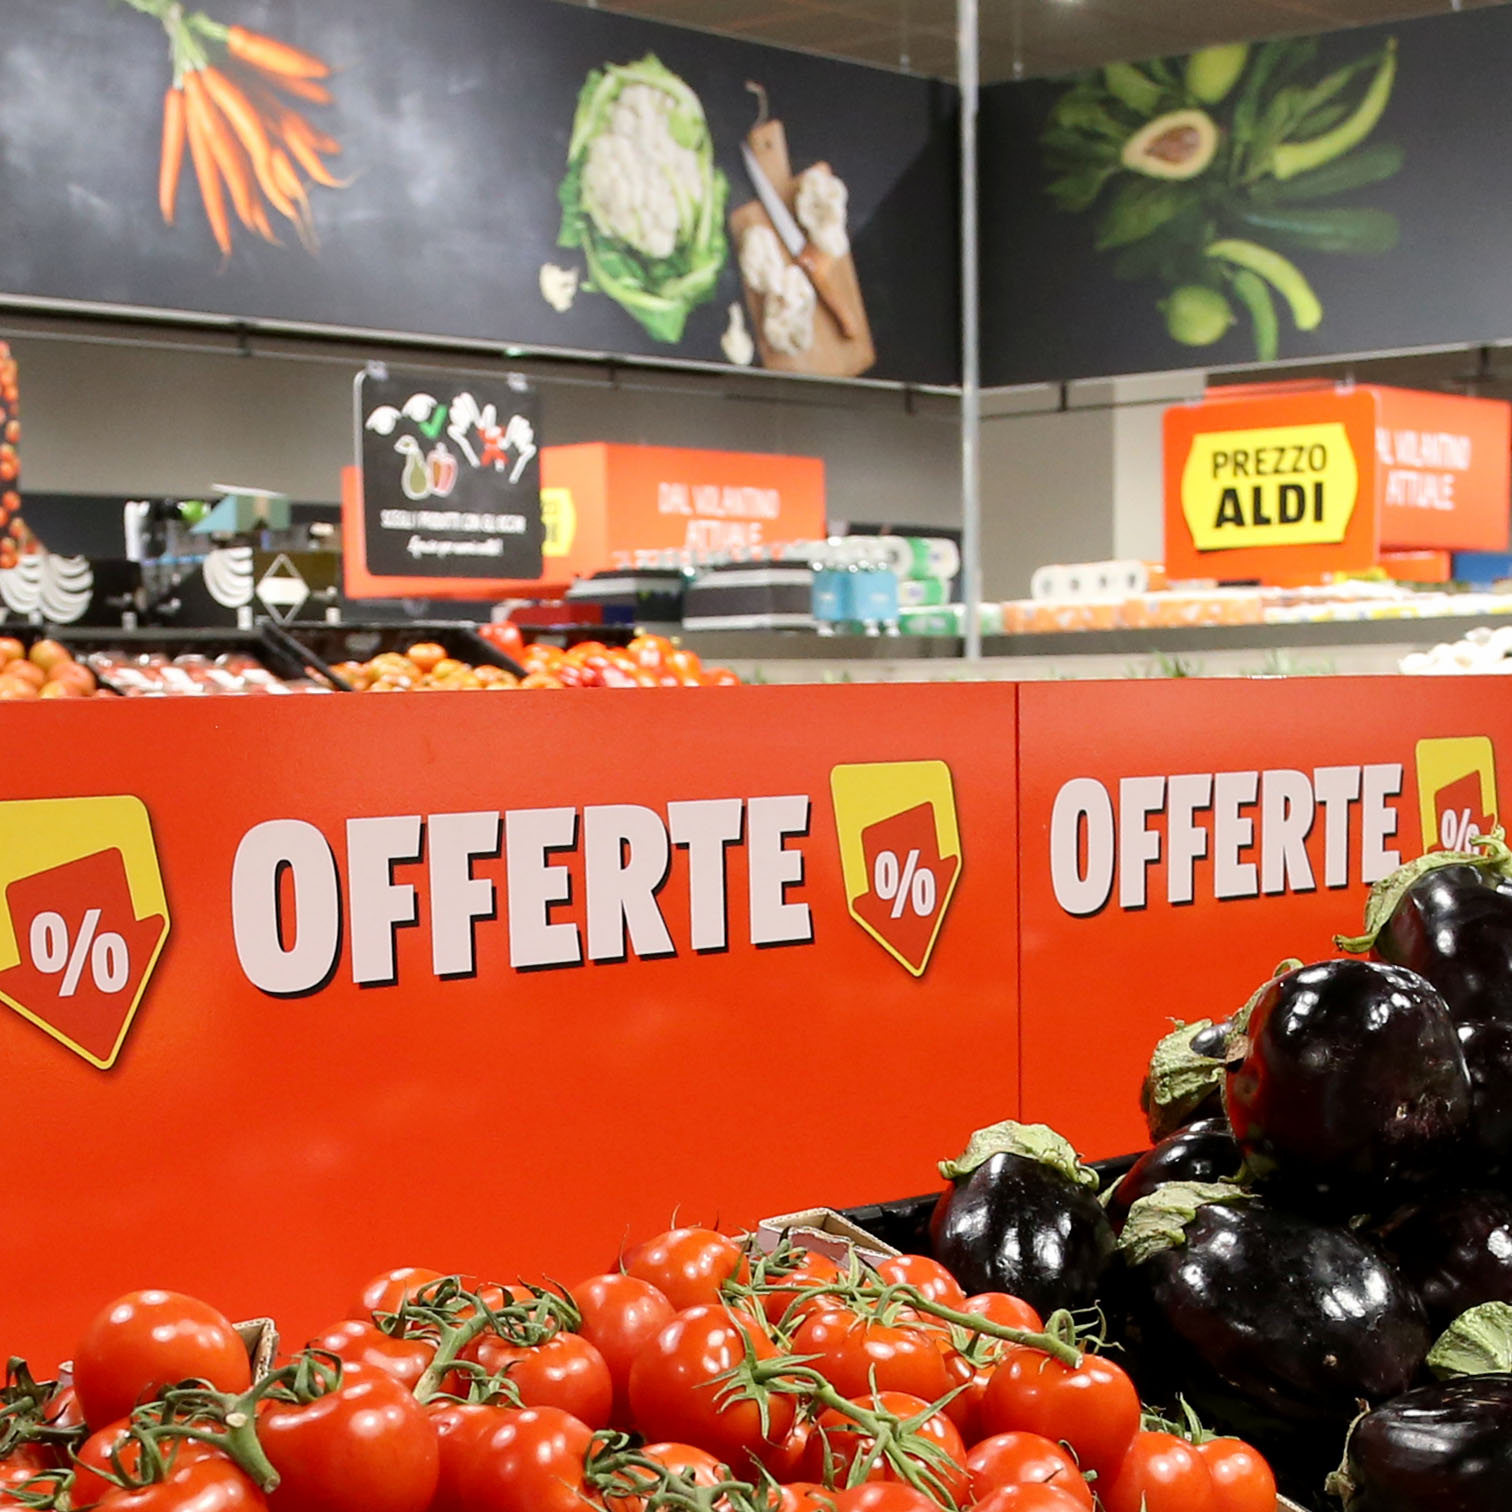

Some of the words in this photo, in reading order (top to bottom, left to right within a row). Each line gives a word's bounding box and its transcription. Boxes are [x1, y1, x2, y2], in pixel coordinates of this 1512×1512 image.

[1213, 444, 1327, 479] PREZZO
[1214, 481, 1324, 529] ALDI
[1050, 764, 1403, 914] OFFERTE
[231, 794, 813, 996] OFFERTE
